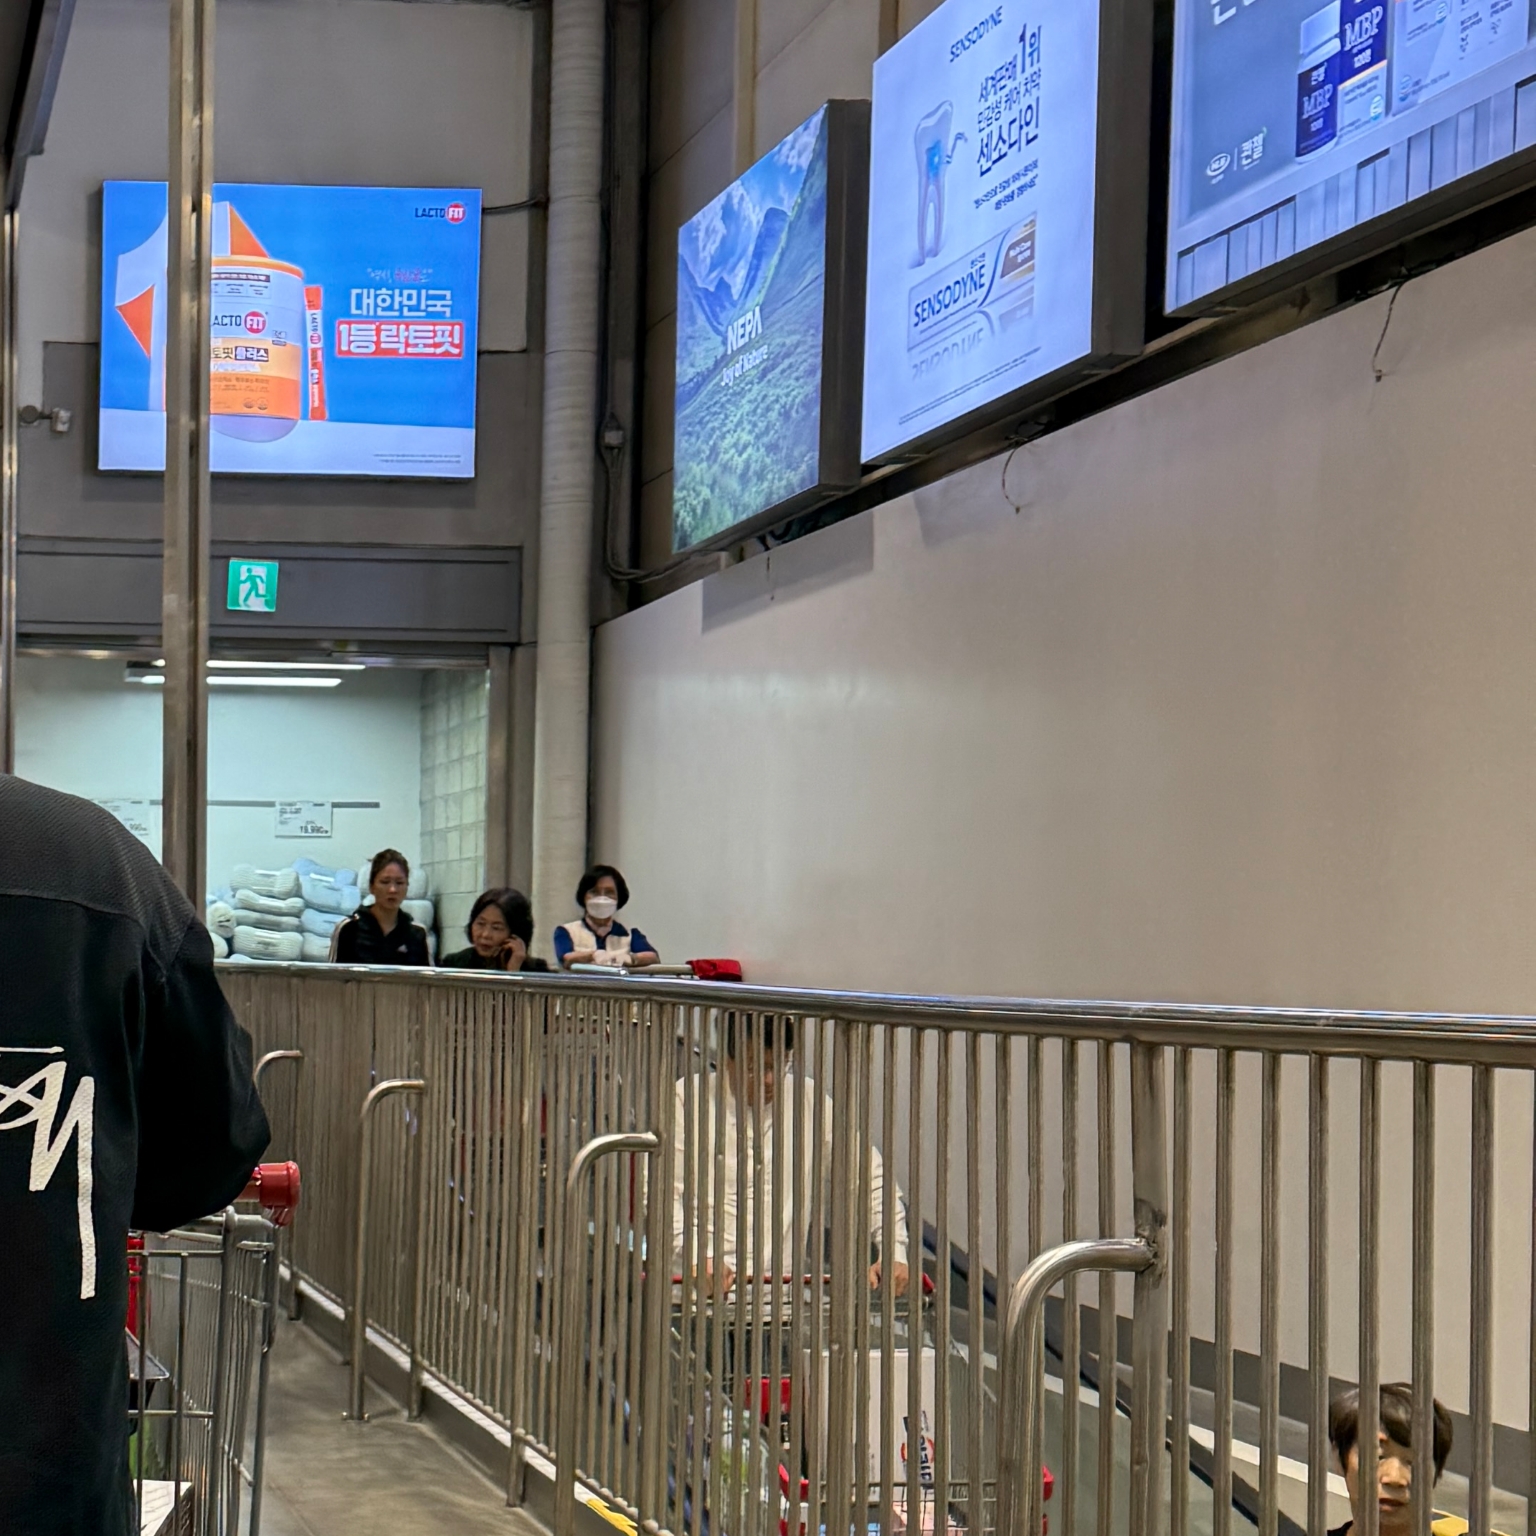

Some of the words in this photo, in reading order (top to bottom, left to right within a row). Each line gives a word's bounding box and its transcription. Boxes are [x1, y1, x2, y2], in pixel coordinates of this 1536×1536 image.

[950, 5, 1003, 62] SENSODYNE
[1344, 6, 1383, 51] MBP
[978, 53, 1018, 103] 세계판매
[1018, 23, 1042, 74] 1위
[1023, 67, 1042, 97] 치약
[1302, 84, 1333, 119] MBP
[977, 95, 1040, 177] 센소다인
[415, 207, 445, 218] LACTO
[448, 207, 464, 219] FIT
[350, 288, 453, 318] 대한민국
[914, 263, 986, 328] SENSODYNE
[212, 314, 242, 327] ACTO
[246, 316, 265, 330] FIT
[339, 323, 377, 354] 1등
[380, 324, 461, 355] 락토핏
[727, 305, 763, 355] NEPA
[212, 347, 234, 360] 토핏
